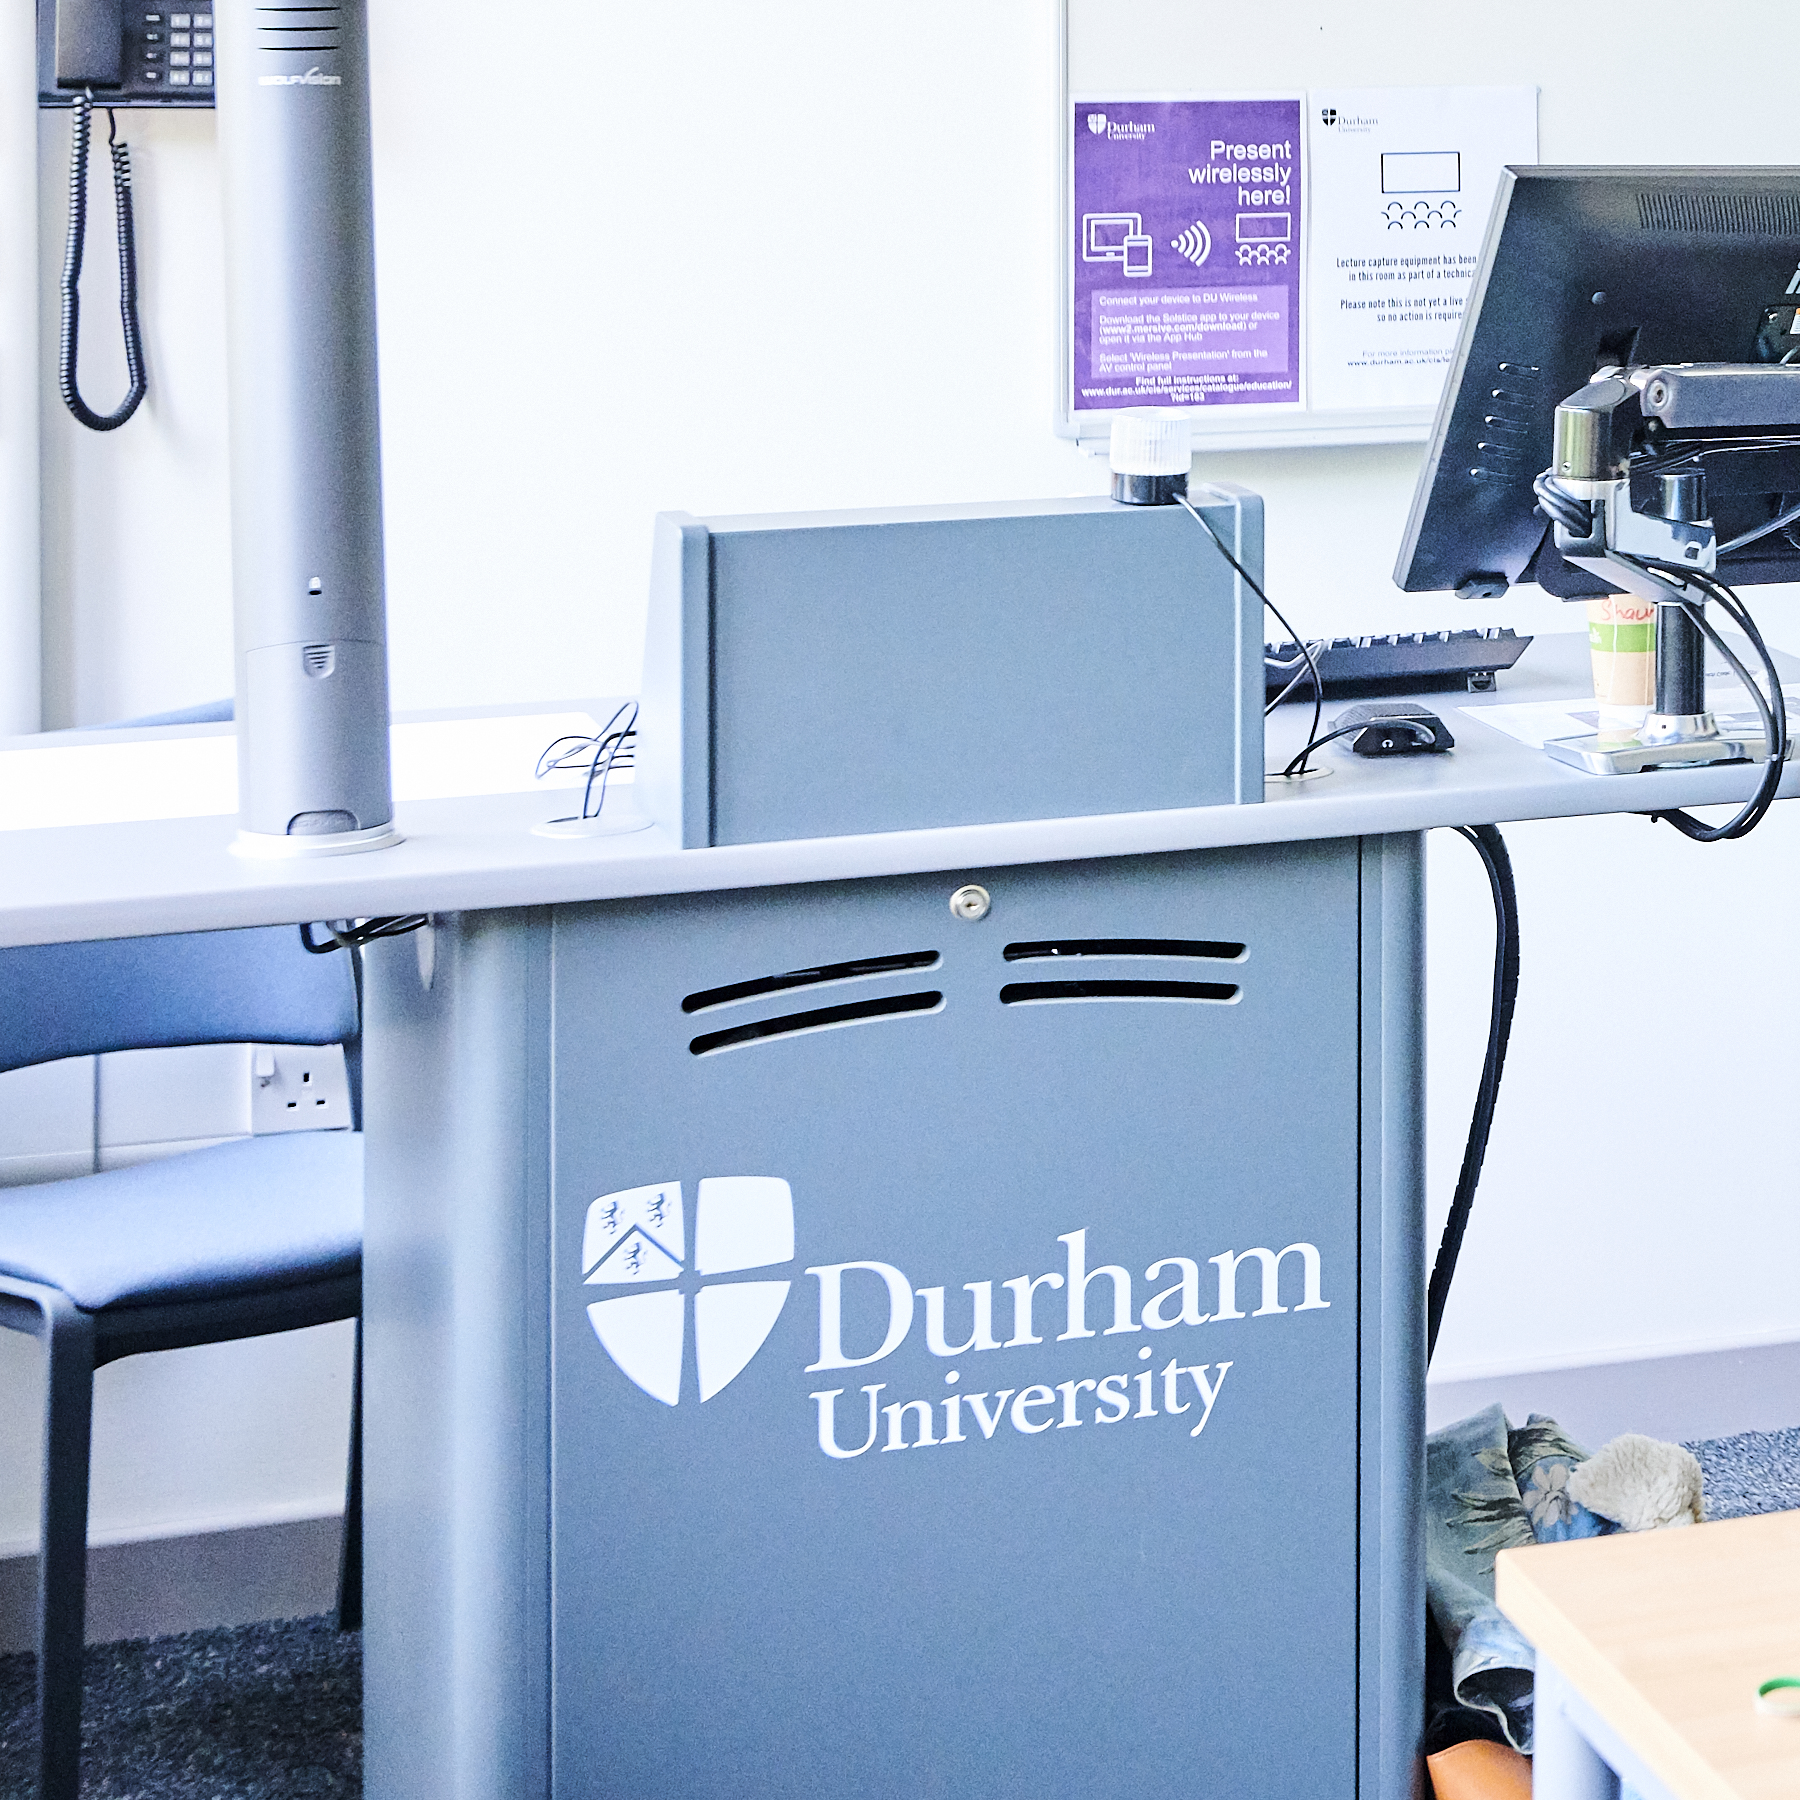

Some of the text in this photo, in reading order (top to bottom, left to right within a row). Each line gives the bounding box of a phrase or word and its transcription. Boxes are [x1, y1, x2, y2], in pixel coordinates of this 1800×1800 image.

[1107, 121, 1155, 133] Durham
[1338, 116, 1379, 126] Durham
[1107, 131, 1146, 140] University
[1209, 140, 1292, 160] Present
[1188, 163, 1292, 186] wirelessly
[1238, 185, 1291, 205] here!
[1336, 254, 1477, 268] Lecture capture equipment has been
[1348, 271, 1356, 281] in
[1358, 271, 1373, 281] this
[1375, 272, 1395, 280] room
[1397, 272, 1406, 280] as
[1408, 269, 1424, 282] part
[1426, 269, 1434, 279] of
[1099, 292, 1258, 307] Connect your device to DU Wireless
[1340, 299, 1366, 309] Please
[1368, 299, 1386, 309] note
[1388, 298, 1403, 308] this
[1405, 298, 1412, 307] is
[1413, 297, 1426, 307] not
[1428, 297, 1440, 308] yet
[1449, 296, 1463, 306] live
[1099, 314, 1144, 325] Download
[1146, 313, 1161, 323] the
[1199, 313, 1217, 322] app
[1219, 312, 1227, 321] to
[1229, 312, 1249, 322] your
[1251, 311, 1279, 320] device
[1377, 310, 1463, 322] so no action is require
[1248, 322, 1258, 330] or
[1099, 332, 1203, 345] open it via the App Hub
[1099, 353, 1127, 363] Select
[1231, 349, 1251, 358] from
[1253, 349, 1268, 358] the
[1099, 361, 1172, 373] AV control panel
[1135, 376, 1156, 386] Find
[1157, 375, 1172, 385] full
[1173, 374, 1225, 384] instructions
[804, 1226, 1332, 1374] Durham
[809, 1345, 1234, 1459] University
